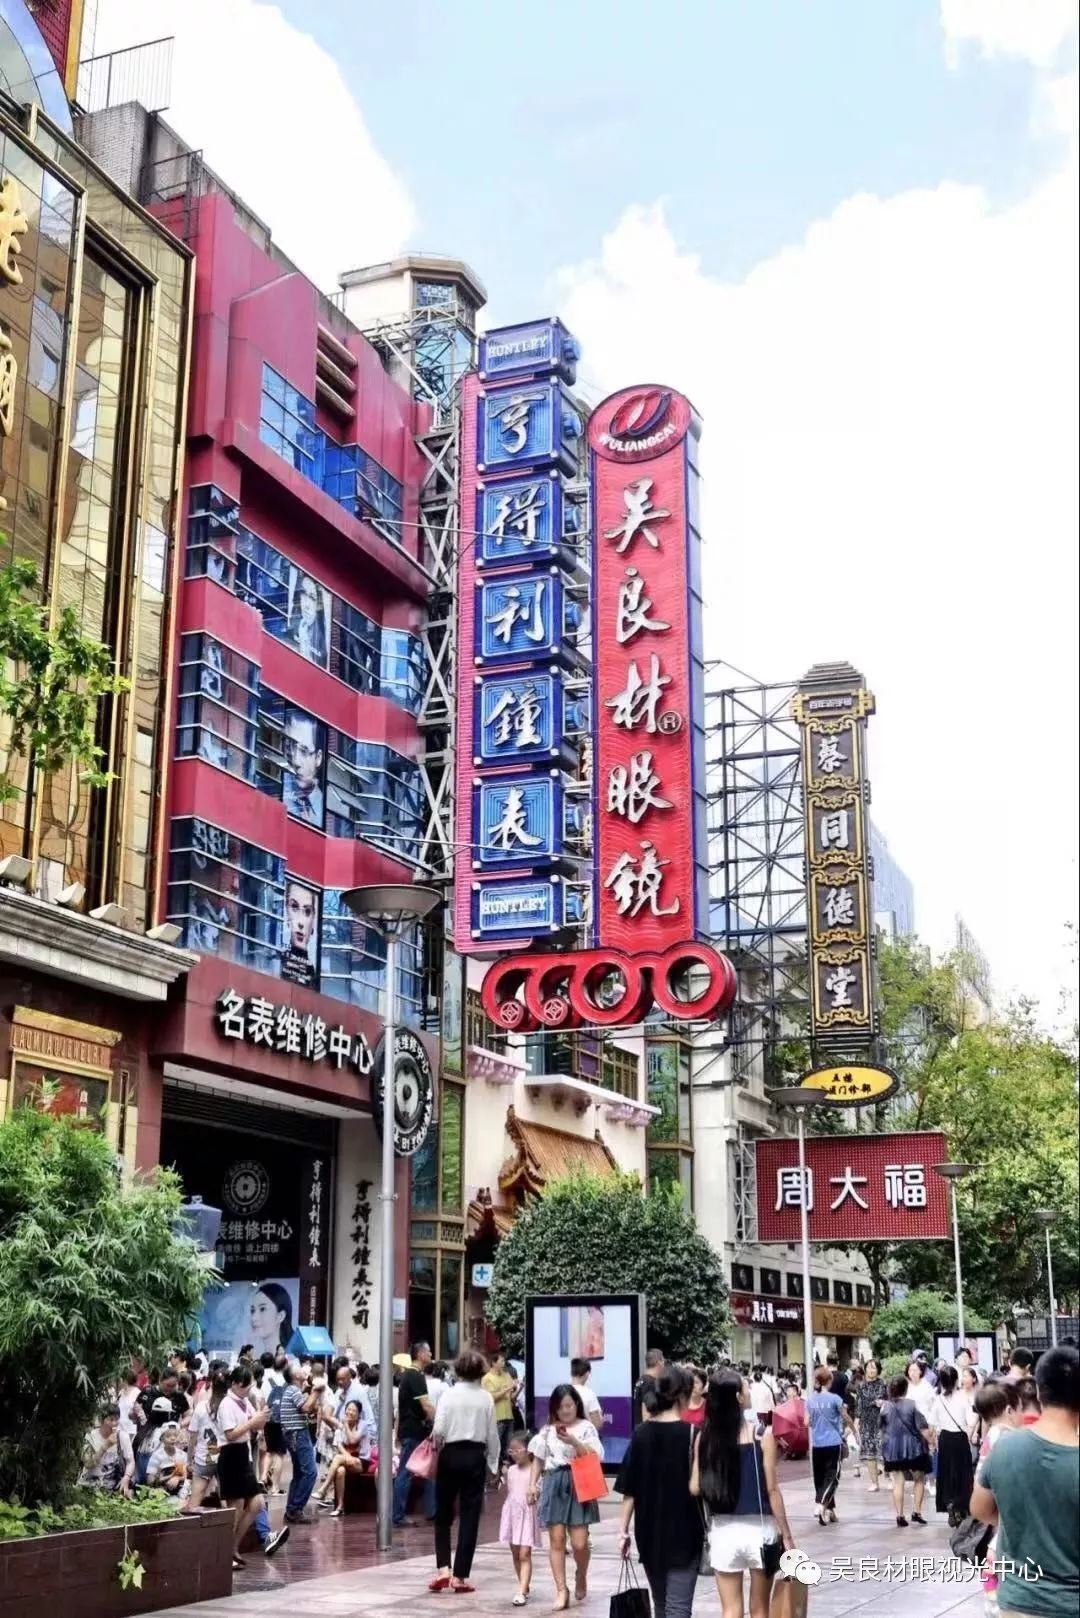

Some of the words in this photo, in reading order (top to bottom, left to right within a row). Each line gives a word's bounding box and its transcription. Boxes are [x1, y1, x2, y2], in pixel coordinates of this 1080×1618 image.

[818, 735, 856, 1008] 蔡同德堂
[218, 986, 375, 1075] 名表维修中心
[775, 1164, 927, 1212] 周大福
